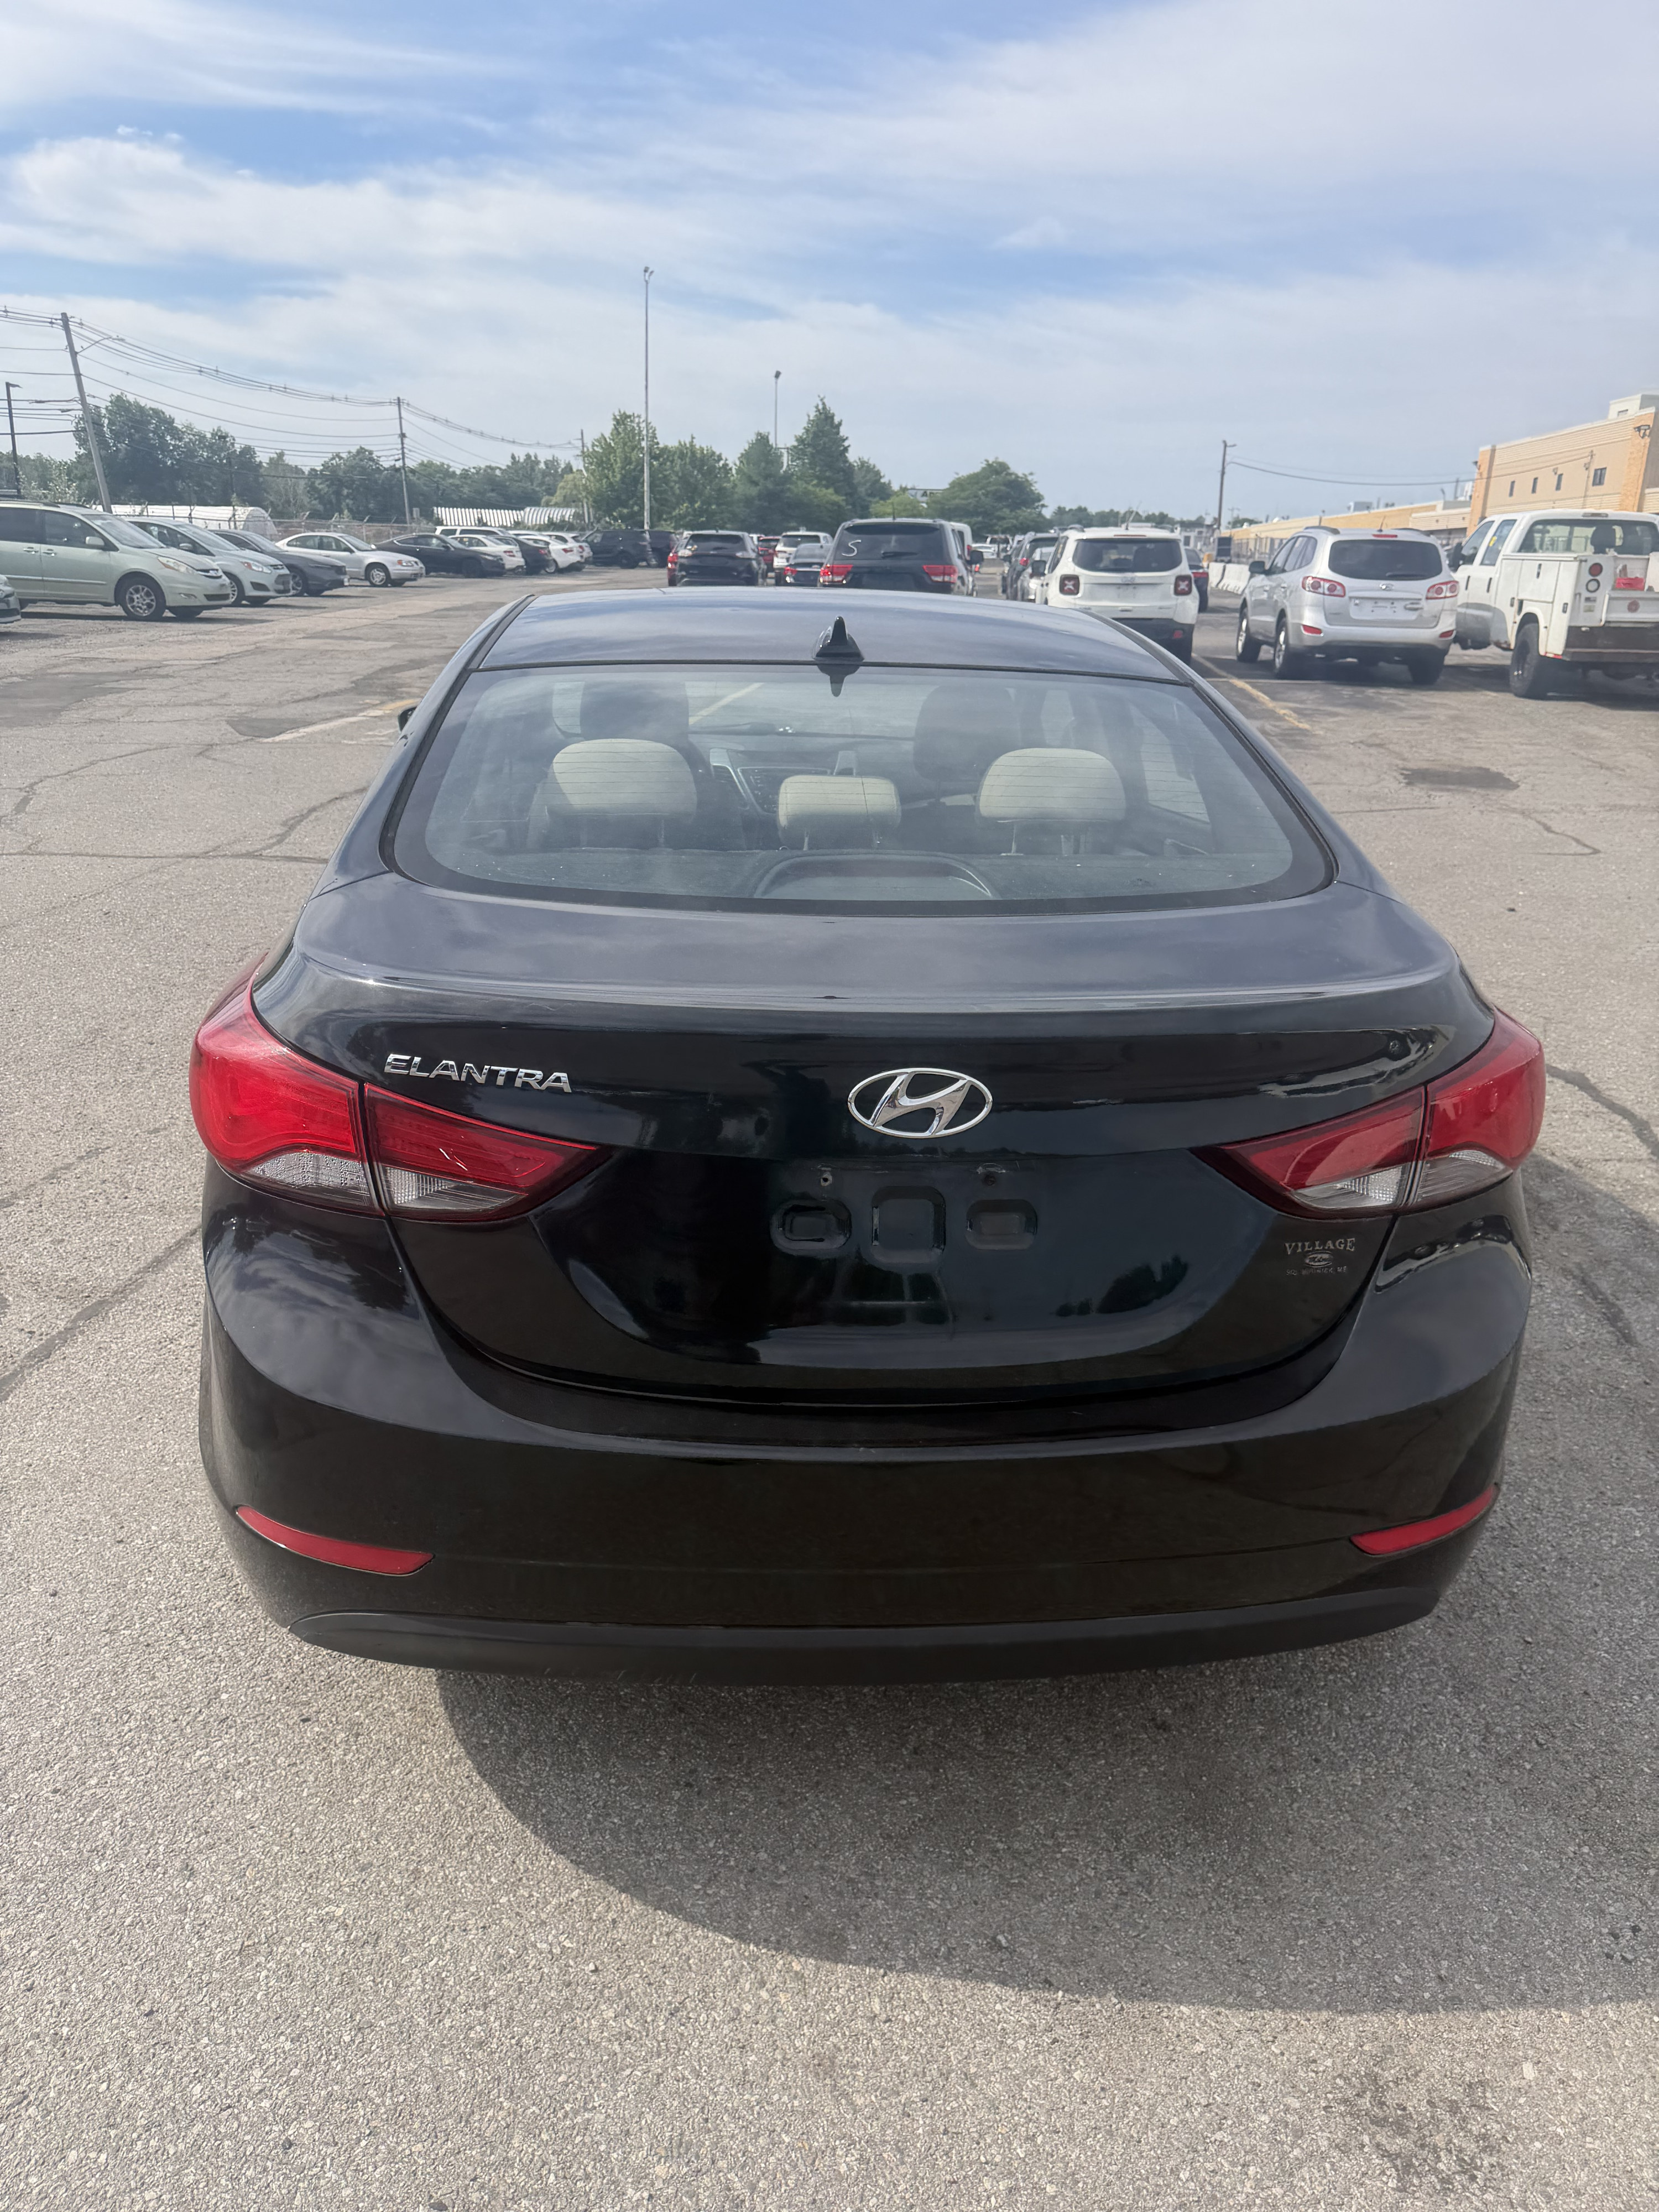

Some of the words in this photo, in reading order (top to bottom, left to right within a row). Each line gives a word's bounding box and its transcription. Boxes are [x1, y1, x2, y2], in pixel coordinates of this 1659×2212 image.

[841, 540, 862, 557] S
[384, 1053, 572, 1093] ELANTRA
[1284, 1238, 1355, 1255] VILLAGE
